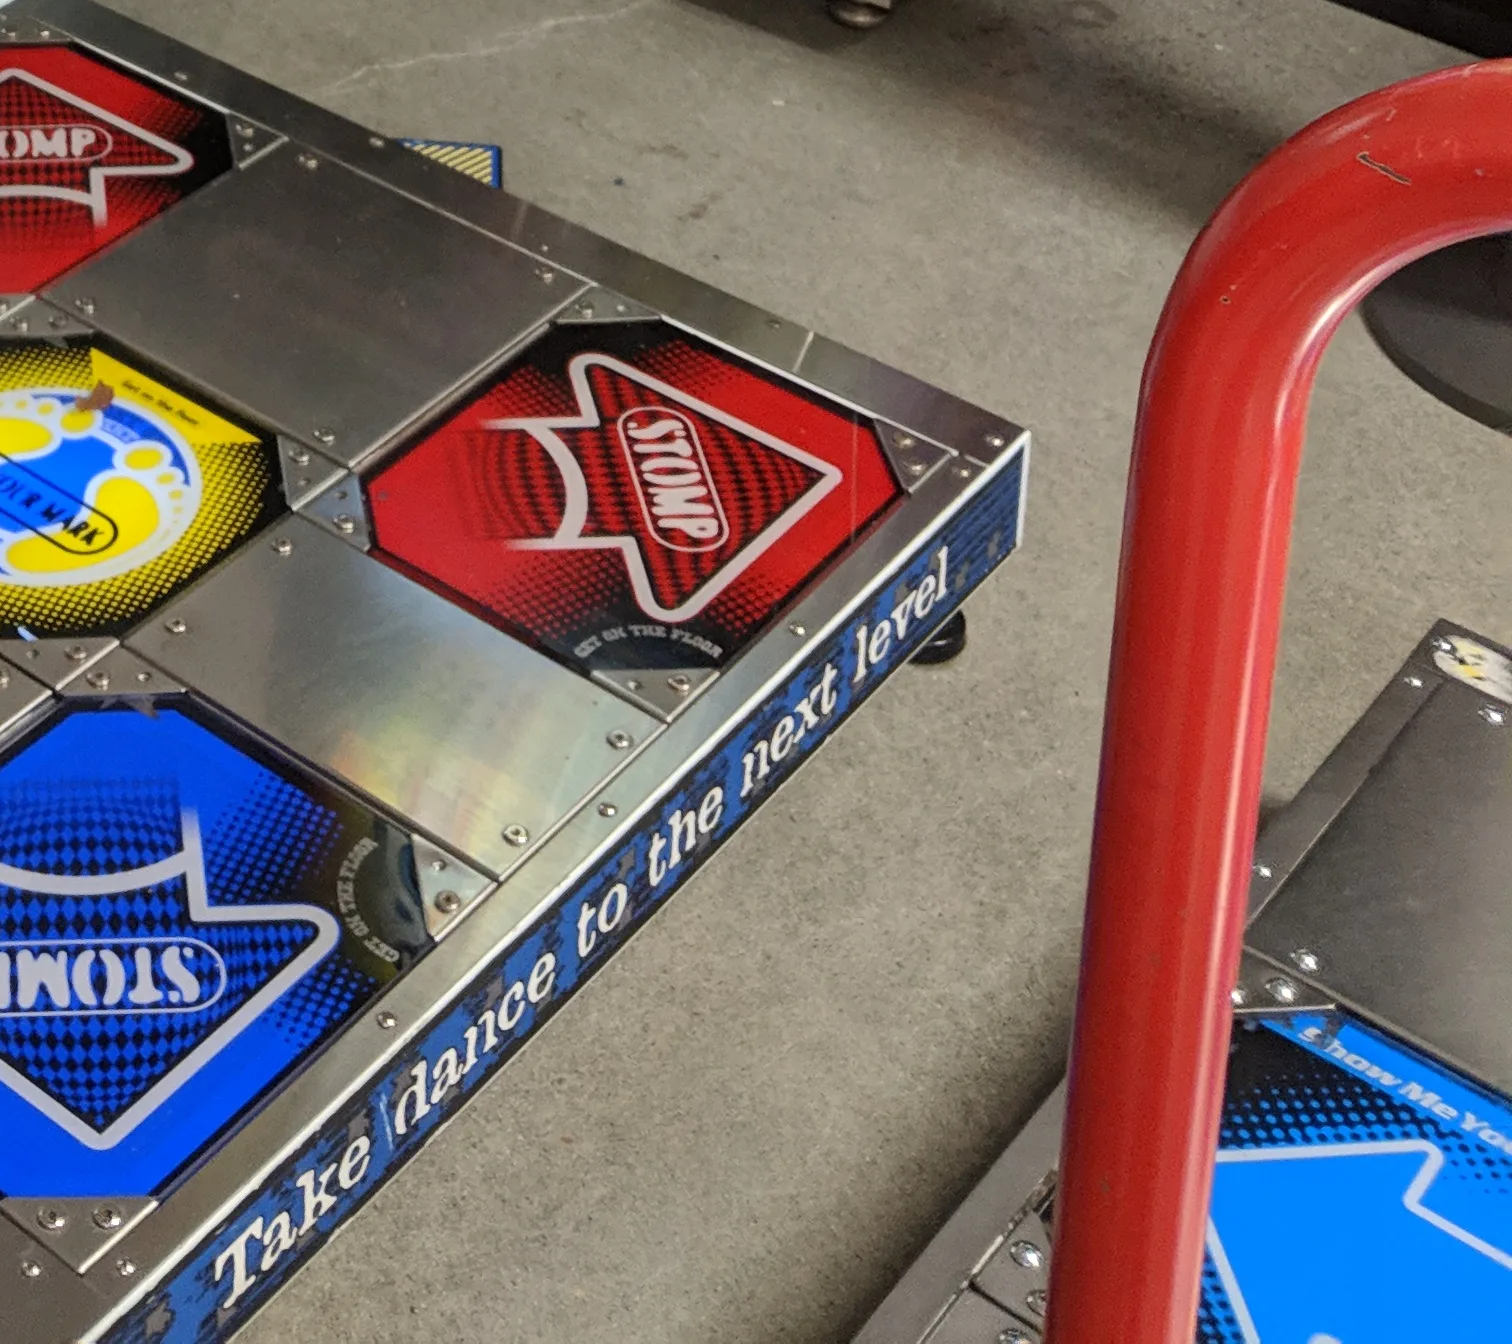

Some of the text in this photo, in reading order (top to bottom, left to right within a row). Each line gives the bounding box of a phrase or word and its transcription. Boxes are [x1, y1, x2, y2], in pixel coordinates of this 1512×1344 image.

[624, 417, 720, 546] STOMP
[40, 504, 104, 546] MARK
[627, 623, 668, 639] THE
[669, 627, 724, 660] FLOOR
[212, 545, 950, 1311] Take dance to the next level
[336, 835, 401, 964] GET ON THE FLOOR
[1397, 1081, 1459, 1121] Me
